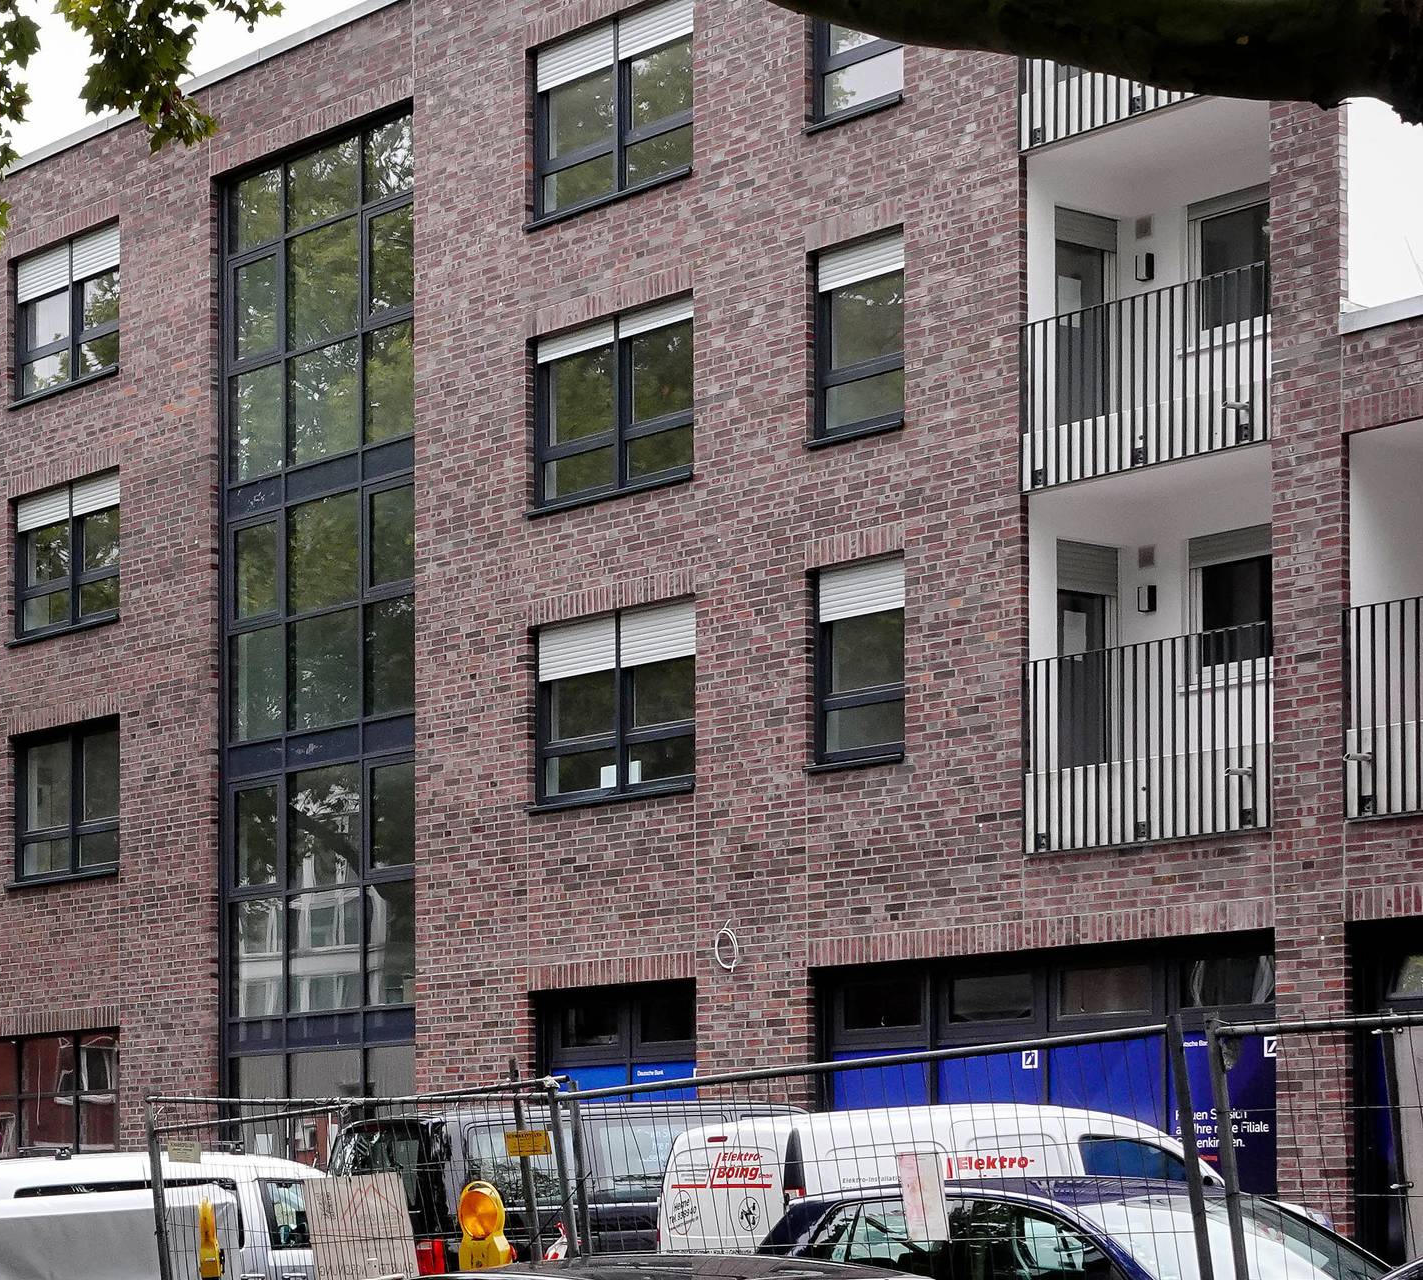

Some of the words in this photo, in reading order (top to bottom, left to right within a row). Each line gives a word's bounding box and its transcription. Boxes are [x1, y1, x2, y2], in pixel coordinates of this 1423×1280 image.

[1241, 1121, 1270, 1133] Filiale
[722, 1151, 764, 1162] Elektro-
[957, 1154, 1035, 1171] Elektro-
